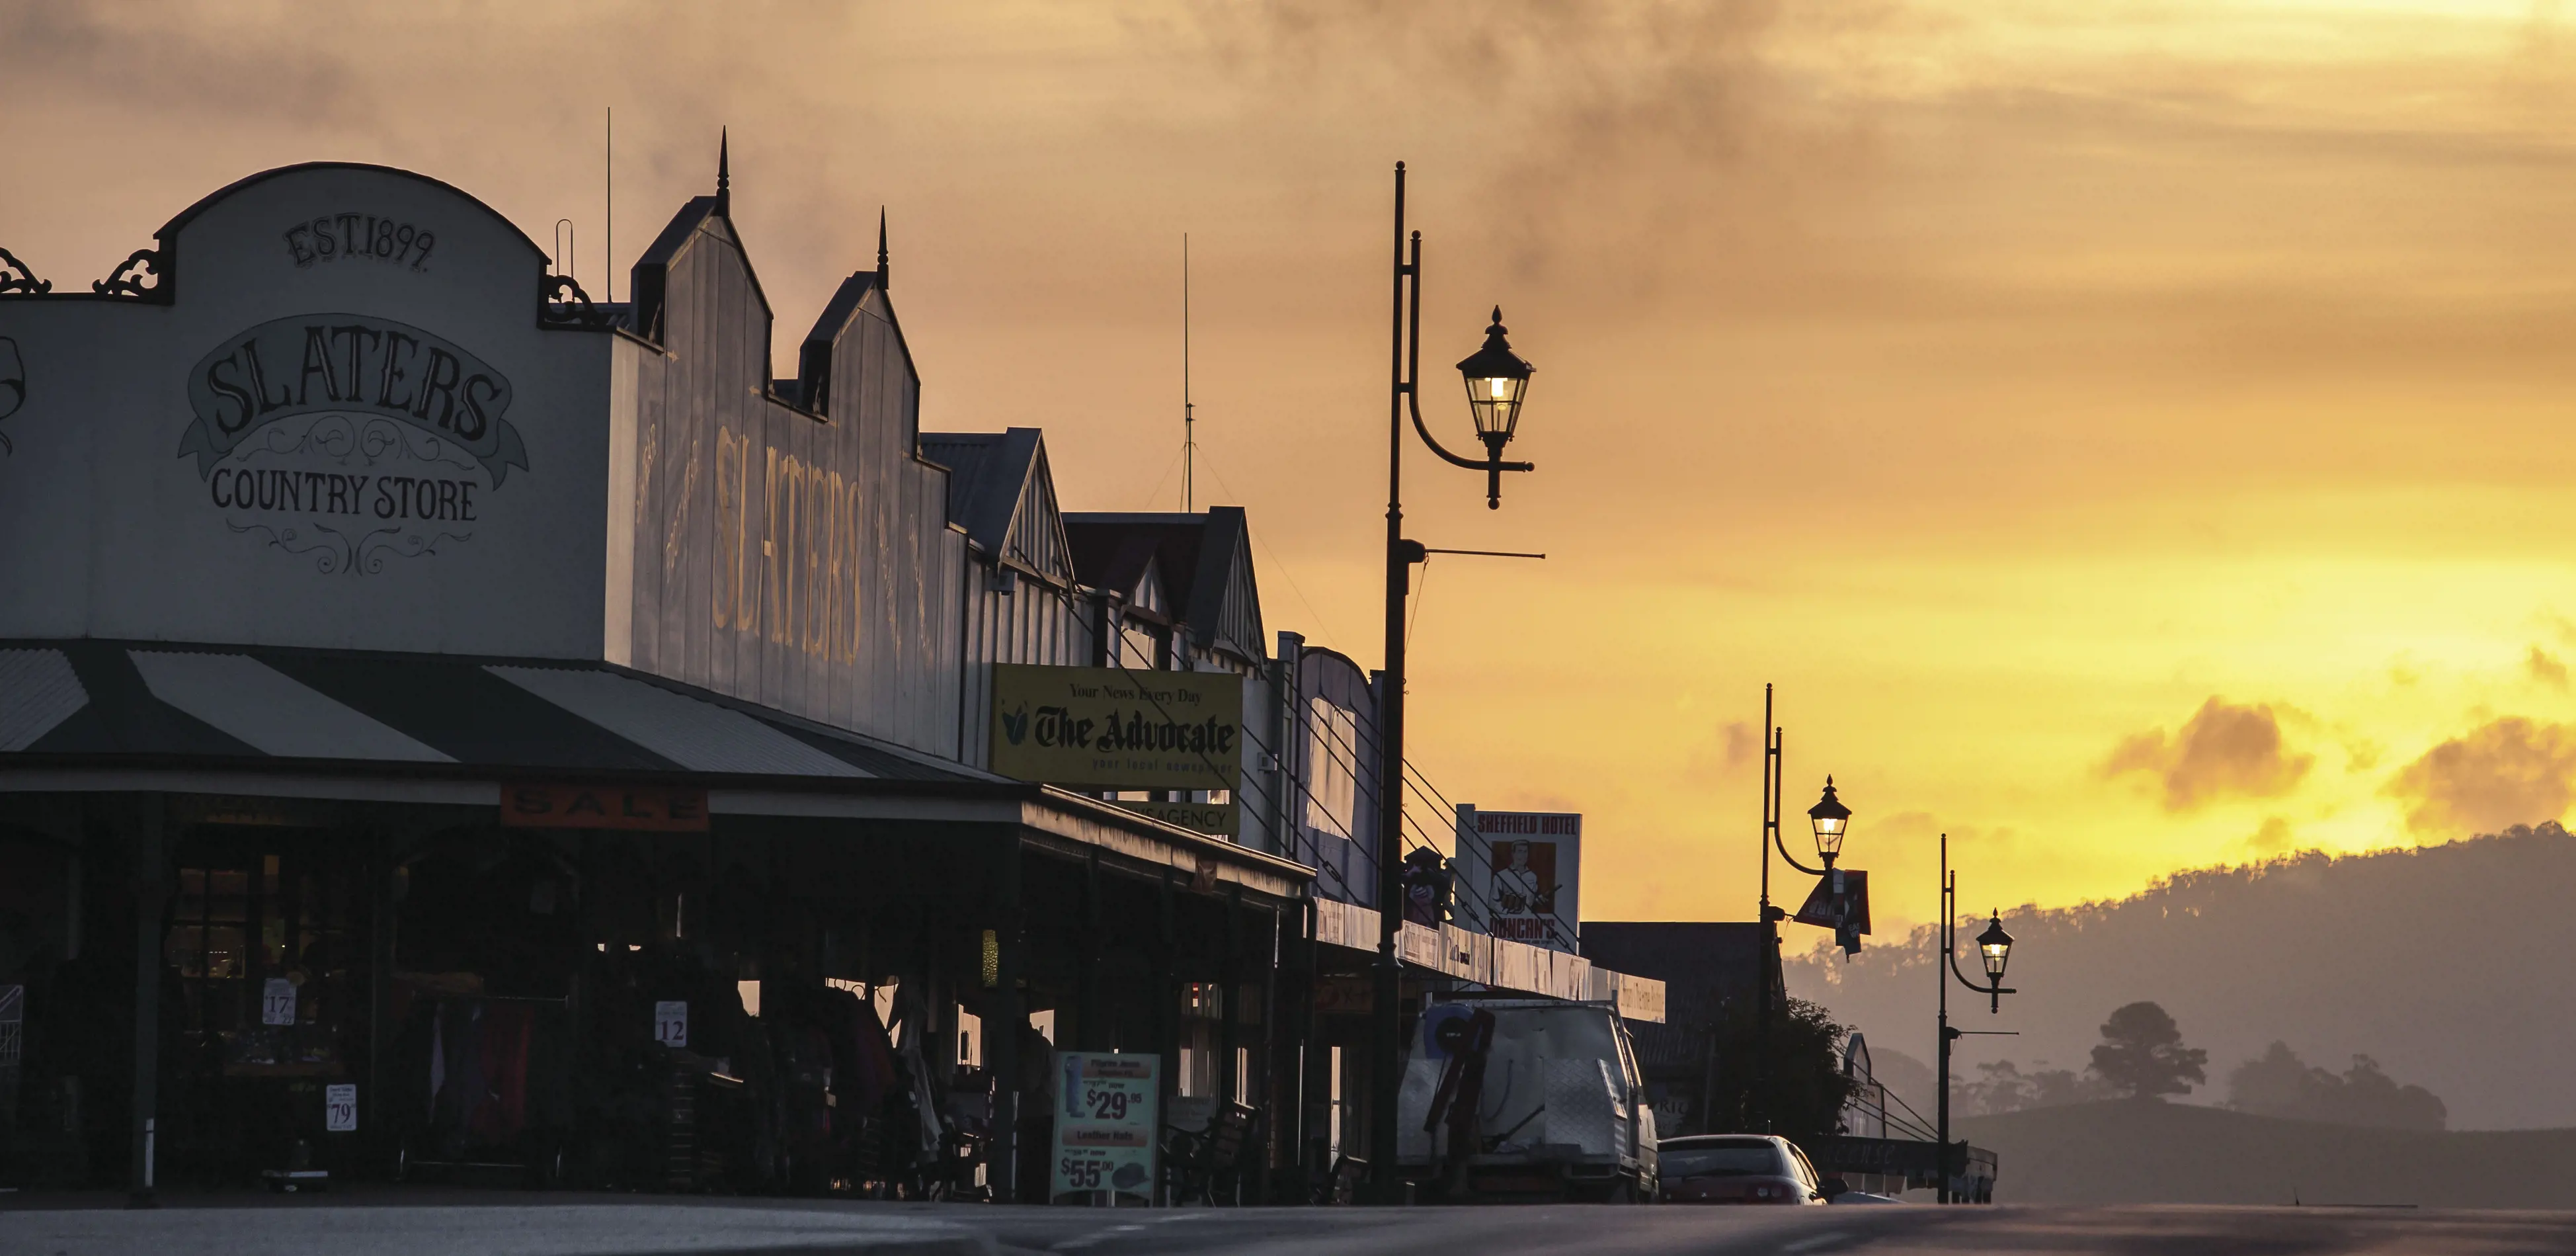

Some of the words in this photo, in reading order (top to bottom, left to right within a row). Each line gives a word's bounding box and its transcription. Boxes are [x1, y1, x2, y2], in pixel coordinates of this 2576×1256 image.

[207, 325, 502, 442] SLATERS
[212, 468, 369, 515] COUNTRY
[374, 476, 477, 521] STORE
[712, 425, 864, 667] SLATERS
[1069, 683, 1099, 698] Your
[1103, 685, 1135, 700] News
[1139, 687, 1176, 705] Every
[1178, 689, 1203, 706] Day
[1035, 705, 1095, 748] The
[1096, 708, 1236, 754] Advocate
[514, 790, 703, 819] SALE
[1477, 814, 1537, 834] SHEFFIELD
[1541, 816, 1577, 835] HOTEL
[1489, 917, 1555, 939] DUNCAN'S
